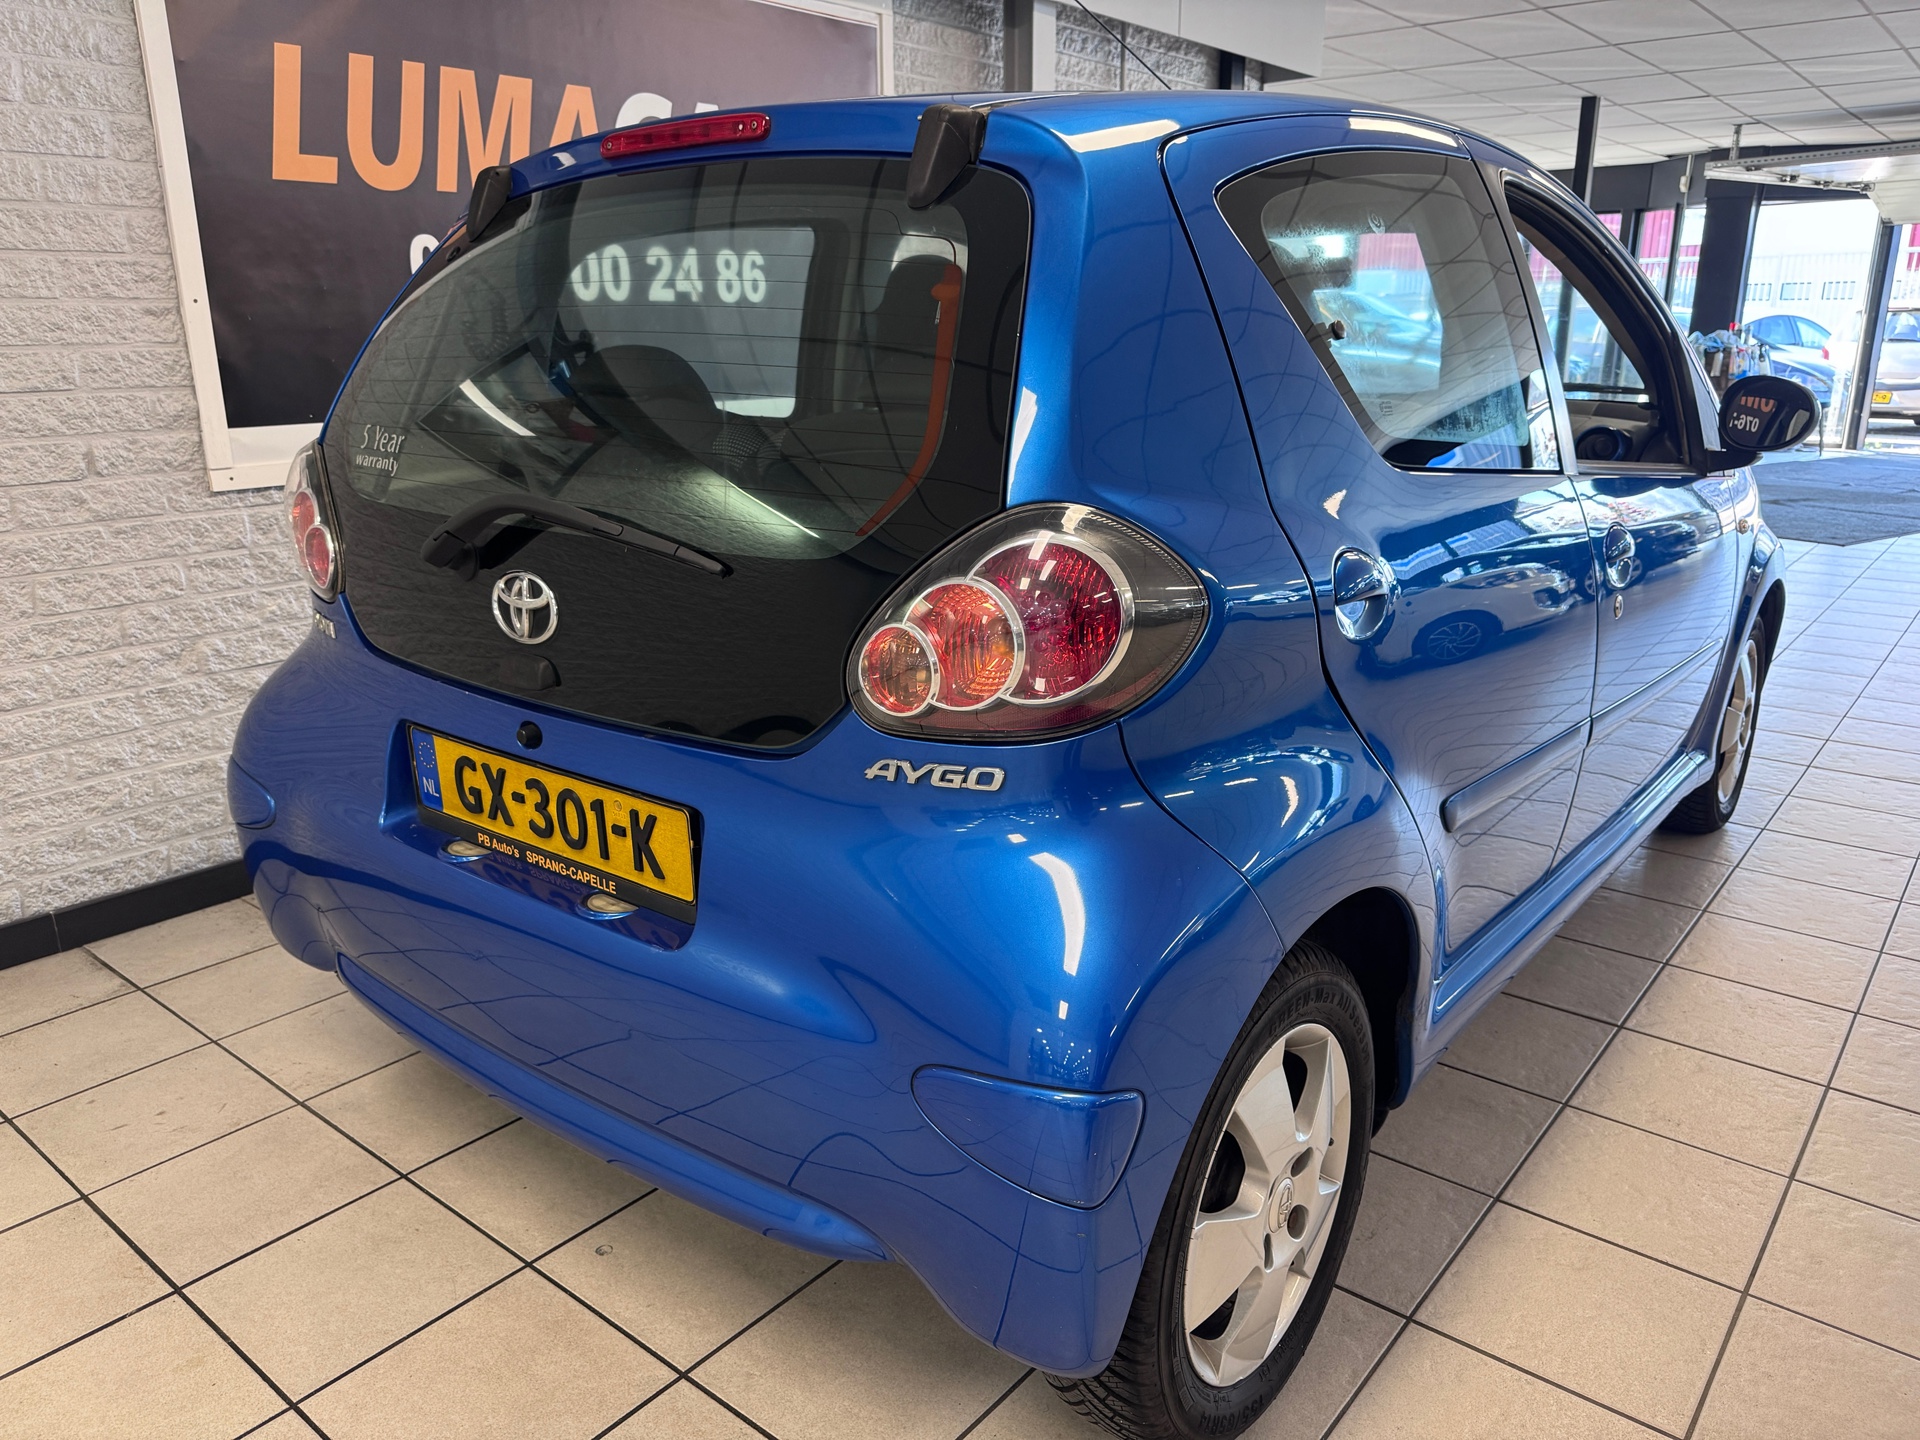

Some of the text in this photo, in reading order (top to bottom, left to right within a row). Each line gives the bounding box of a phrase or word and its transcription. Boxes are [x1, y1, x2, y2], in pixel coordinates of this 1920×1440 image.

[272, 42, 719, 193] LUMA
[646, 245, 703, 303] 24
[716, 248, 768, 304] 86
[361, 424, 406, 453] 5 Year
[355, 453, 399, 476] warranty
[422, 776, 440, 798] NL
[864, 758, 1006, 793] AYGO
[453, 755, 666, 881] GX-301-K
[477, 832, 491, 848] PB
[492, 838, 520, 859] Auto's
[525, 851, 617, 895] SPRANG-CAPELLE
